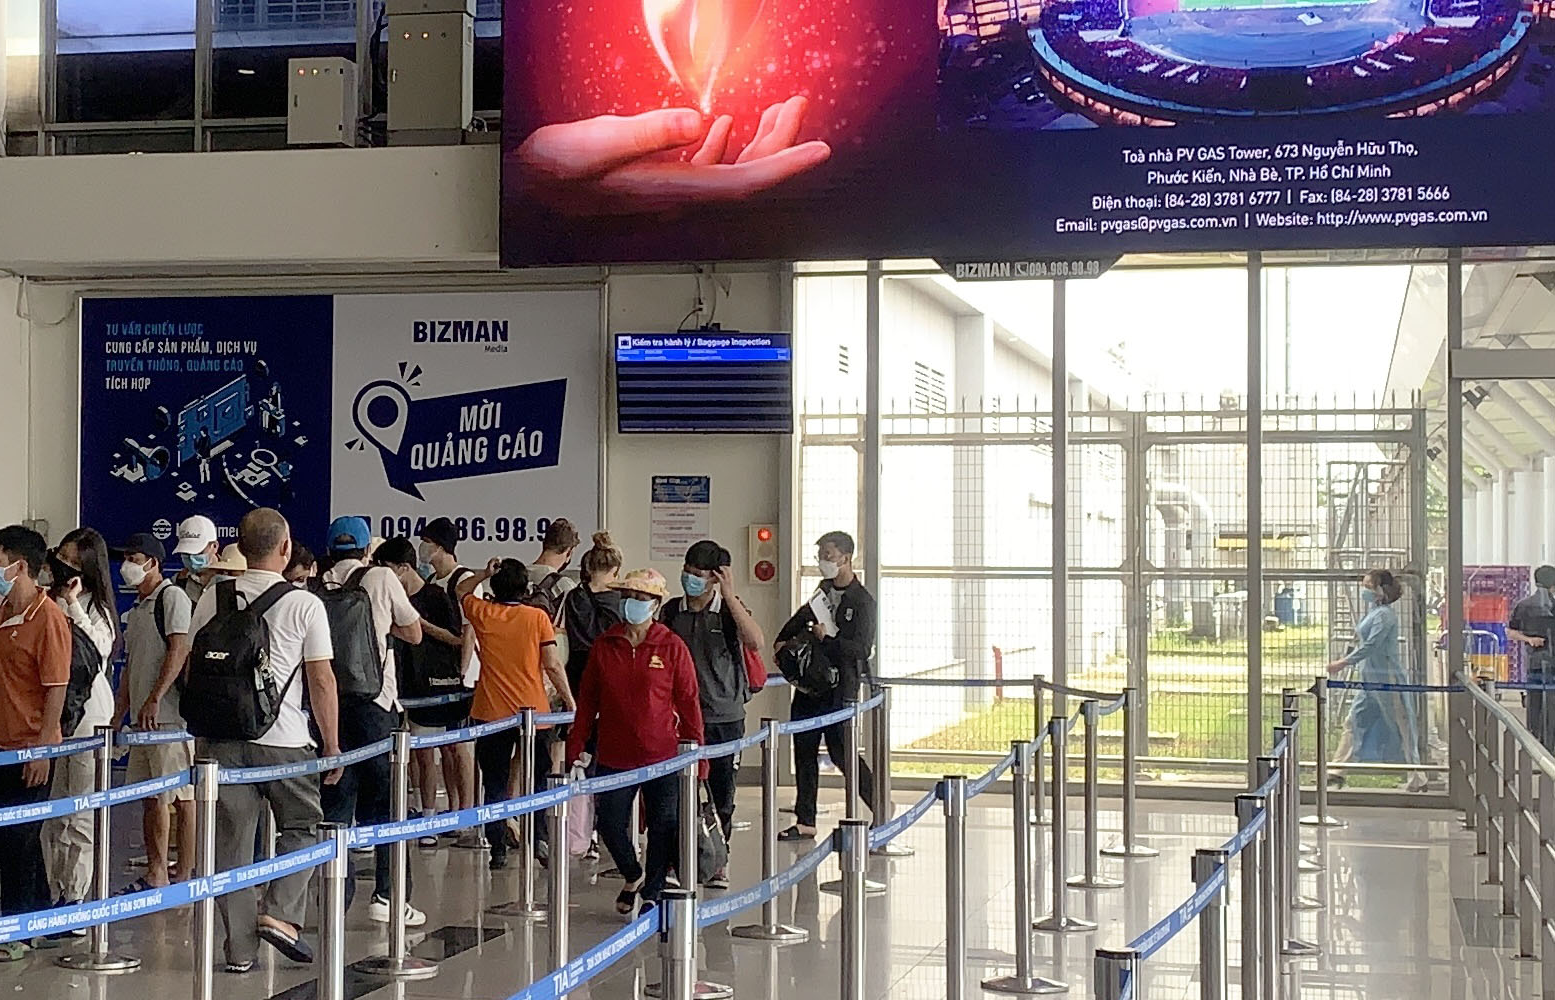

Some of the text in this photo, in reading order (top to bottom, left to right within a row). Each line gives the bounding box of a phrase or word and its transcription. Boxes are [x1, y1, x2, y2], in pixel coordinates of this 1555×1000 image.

[1123, 139, 1419, 164] Toà nhà PV GAS Tower, 673 Nguyễn Hữu Thọ,
[1147, 163, 1391, 185] Phước Kiển, Nhà Bè, TP. Hồ Chí Minh
[1092, 186, 1450, 211] Điện thoại: (84-28) 3781 6777 Fax: (84-28) 3781 5666
[1056, 209, 1487, 234] Email: pvgas@pvgas.com.vn Website: http://www.pvgas.com.vn
[956, 262, 1011, 279] BIZMAN
[413, 320, 509, 343] BIZMAN
[105, 341, 132, 354] CUNG
[135, 338, 154, 354] CẤP
[157, 338, 178, 354] SẢN
[216, 341, 241, 355] DỊCH
[244, 341, 257, 355] VỤ
[484, 345, 508, 353] Media
[697, 338, 730, 348] Baggage
[105, 375, 151, 392] TÍCH HỢP
[459, 399, 502, 433] MỜI
[410, 426, 544, 471] QUẢNG CÁO
[381, 516, 551, 542] 09486.98.9
[204, 651, 230, 660] acer
[73, 797, 89, 811] TIA
[477, 808, 490, 821] TIA
[27, 917, 47, 933] CẢNG
[92, 899, 111, 919] QUỐC
[188, 882, 210, 899] TIA
[553, 970, 569, 996] TIA
